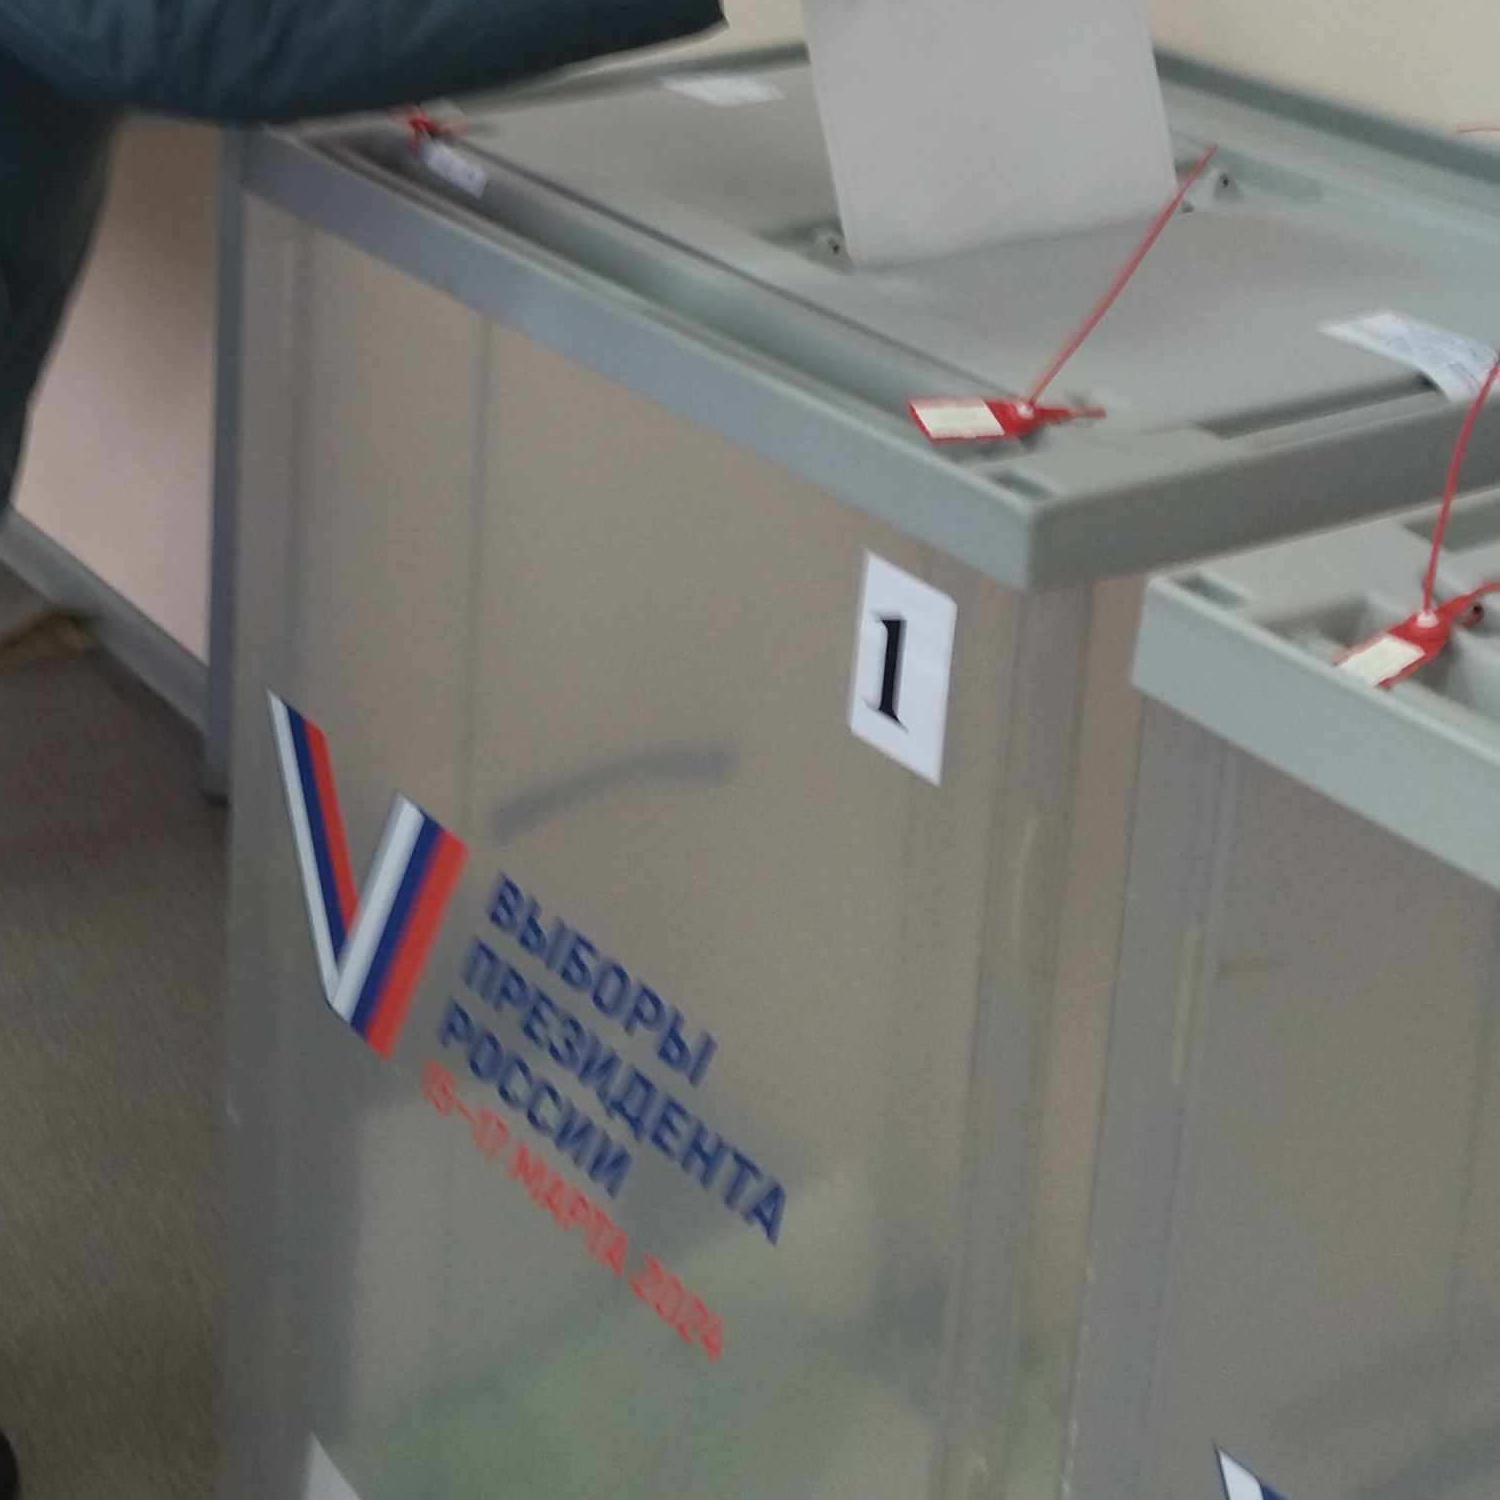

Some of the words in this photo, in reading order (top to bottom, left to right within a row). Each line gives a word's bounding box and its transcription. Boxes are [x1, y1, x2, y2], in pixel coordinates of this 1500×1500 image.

[869, 612, 909, 733] 1
[488, 873, 717, 1087] ВЫБОРЫ
[438, 1000, 632, 1198] РОССИИ
[463, 938, 786, 1245] ПРЕЗИДЕНТА
[508, 1138, 627, 1277] МАРТА
[629, 1252, 724, 1363] 2024
